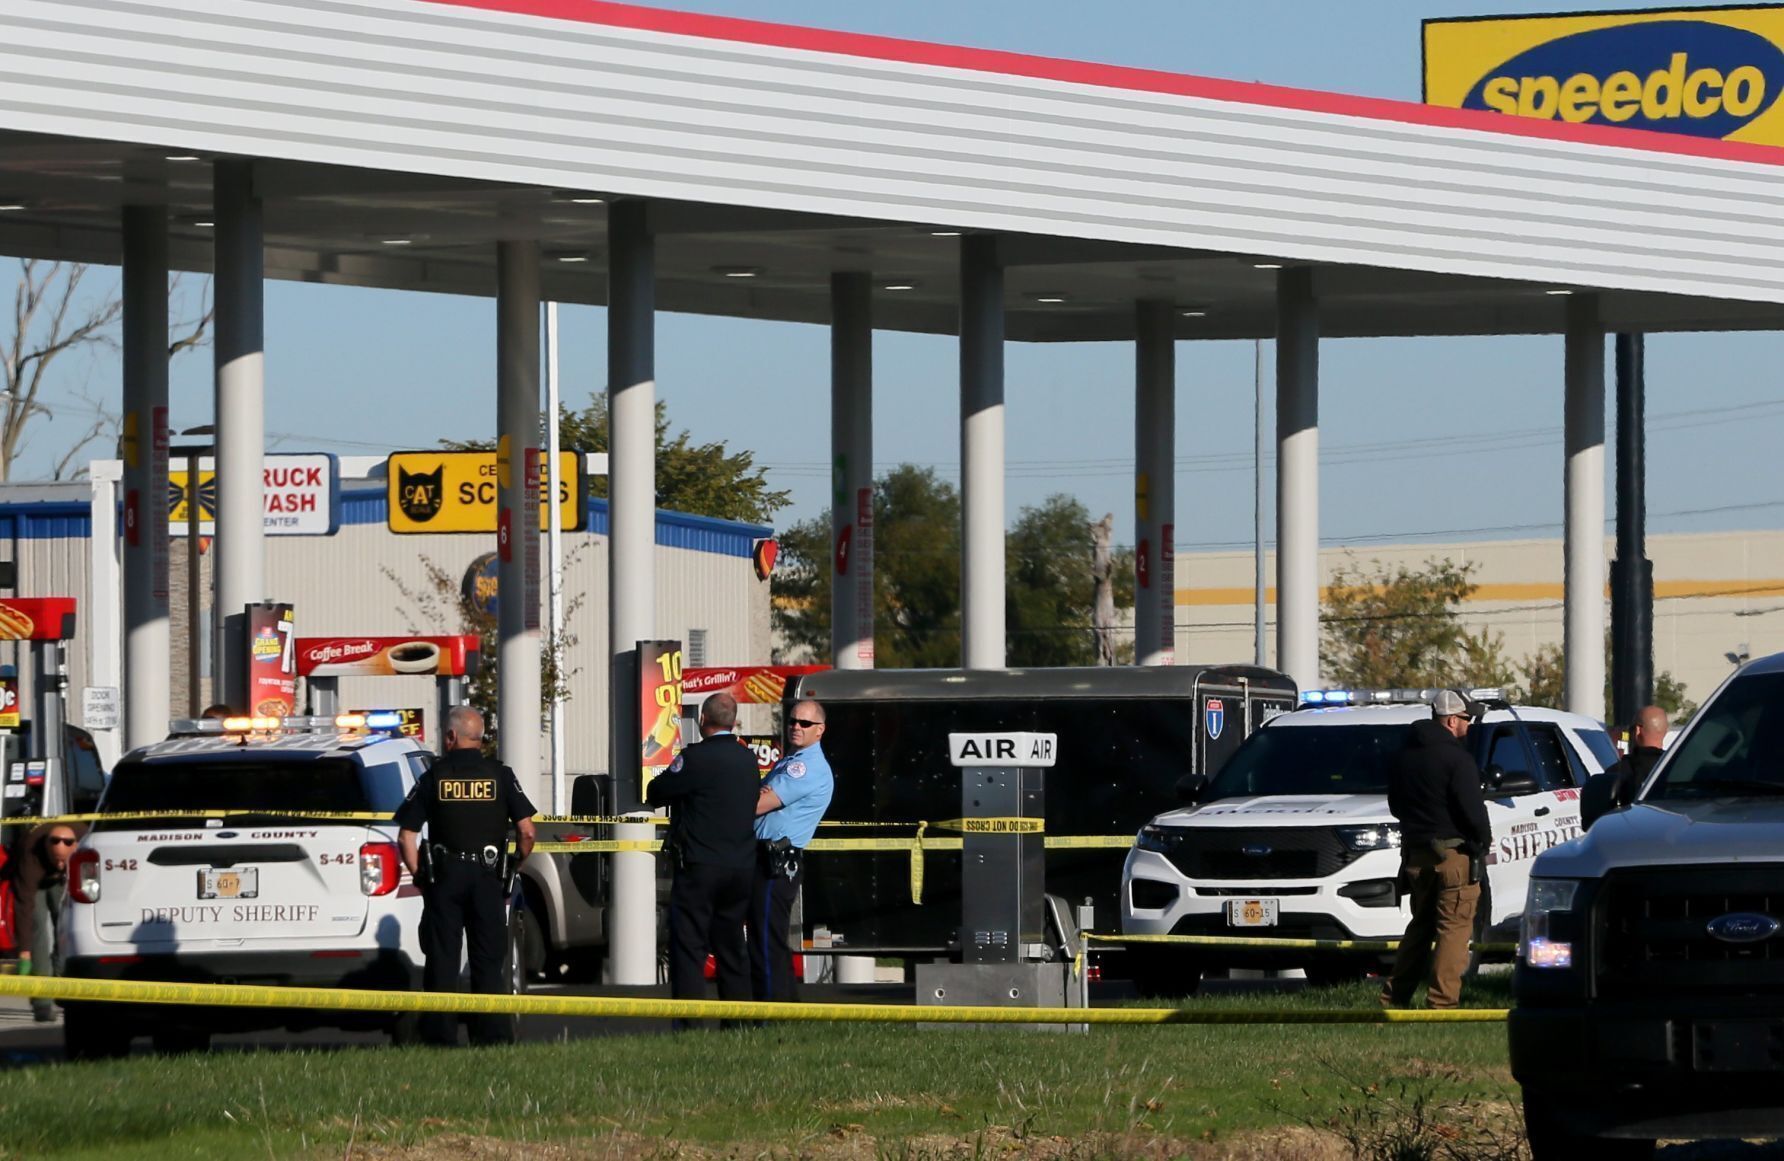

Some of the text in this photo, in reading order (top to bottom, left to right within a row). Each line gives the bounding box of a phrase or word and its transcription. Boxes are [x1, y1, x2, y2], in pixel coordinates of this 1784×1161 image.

[1483, 53, 1765, 123] speedco
[263, 467, 322, 488] RUCK
[263, 493, 316, 513] ASH
[404, 484, 435, 505] CAT
[127, 508, 134, 528] 8
[263, 517, 299, 527] ENTER
[501, 525, 507, 544] 6
[1139, 554, 1146, 572] 2
[310, 640, 373, 663] Coffee Break
[683, 671, 737, 690] hat's Grillin'?
[960, 739, 1017, 759] AIR
[1031, 739, 1052, 759] AIR
[443, 781, 492, 799] POLICE
[966, 821, 991, 832] CROSS
[993, 820, 1007, 831] NOT
[1511, 815, 1580, 836] MADISON COUNTY
[137, 831, 318, 842] MADISON COUNTY
[105, 859, 138, 871] S-42
[319, 853, 354, 865] S-42
[141, 905, 319, 924] DEPUTY SHERIFF
